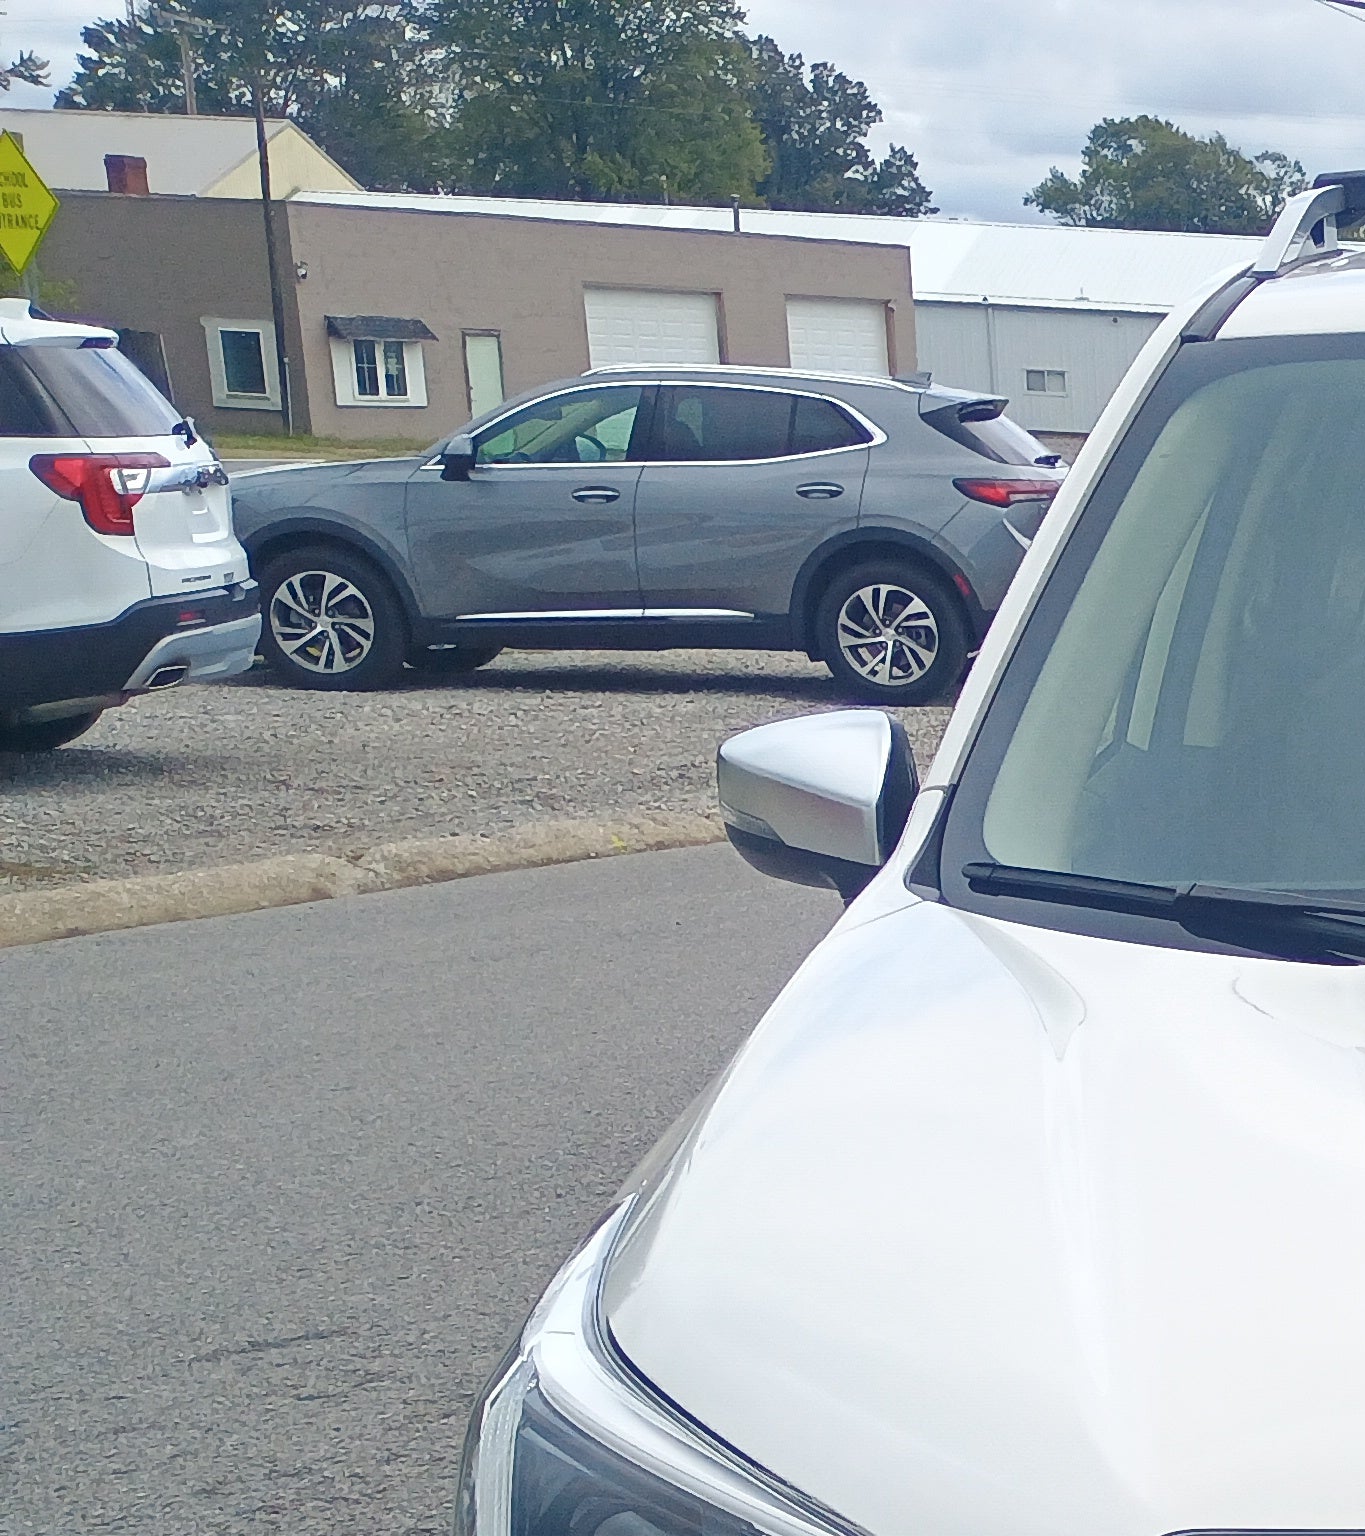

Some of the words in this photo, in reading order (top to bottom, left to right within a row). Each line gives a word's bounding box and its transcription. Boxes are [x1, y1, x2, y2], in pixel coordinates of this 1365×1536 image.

[0, 171, 28, 188] CHOOL
[2, 191, 23, 209] BUS
[0, 212, 42, 231] TRANCE
